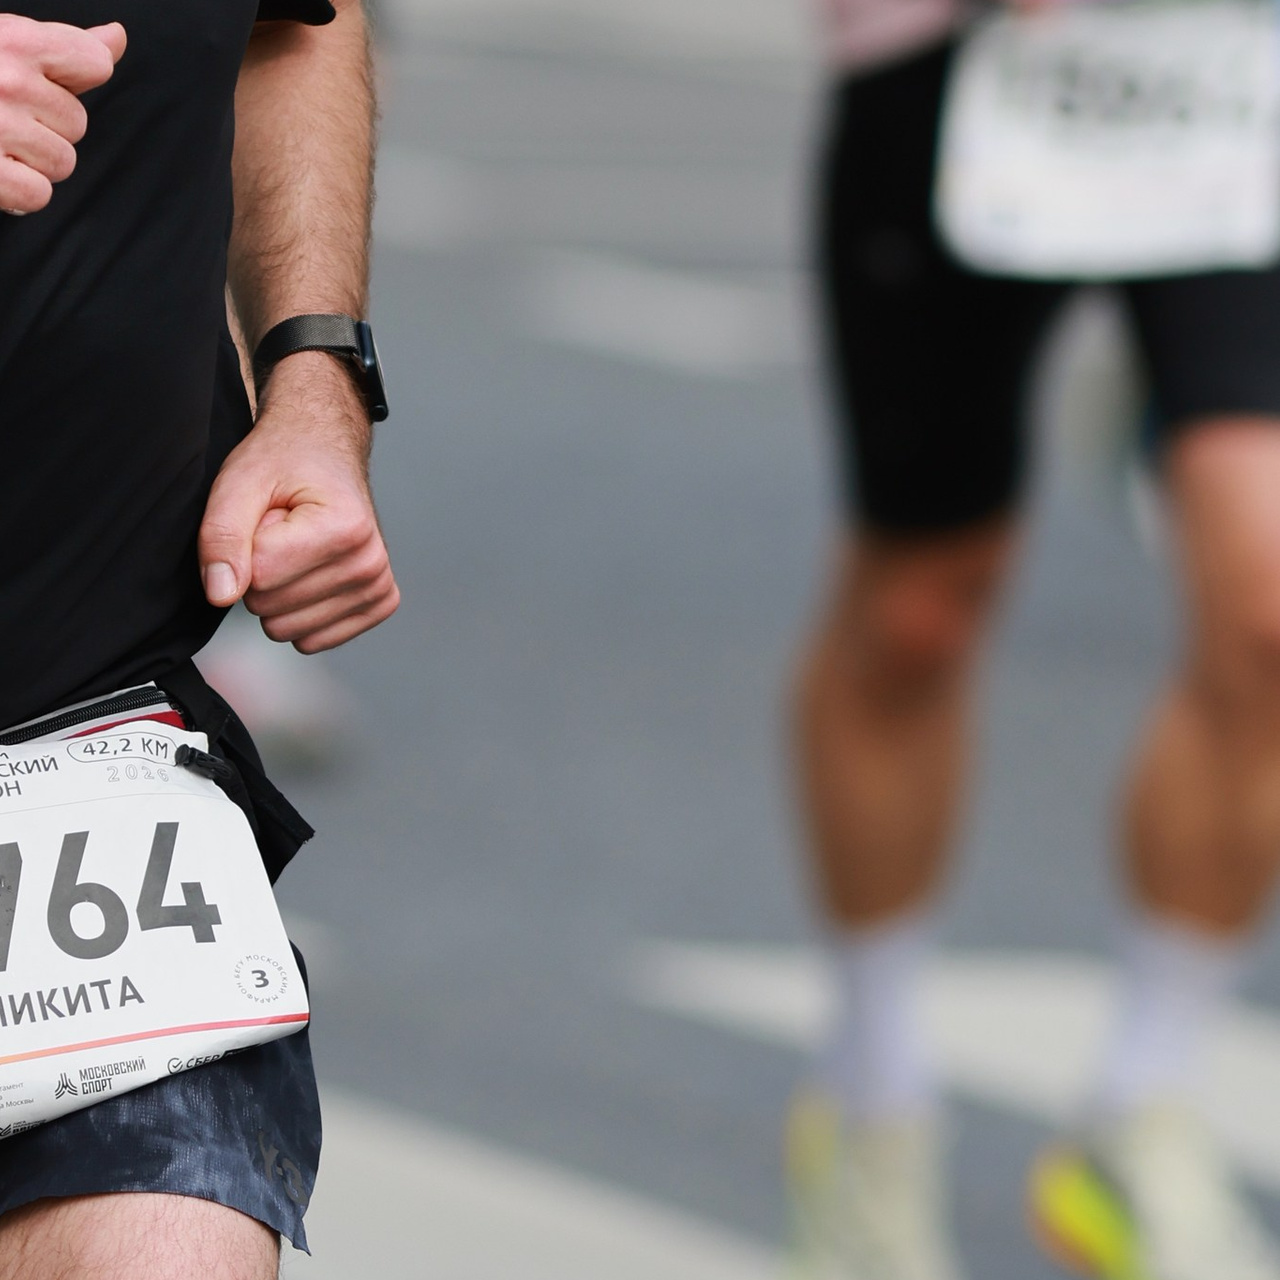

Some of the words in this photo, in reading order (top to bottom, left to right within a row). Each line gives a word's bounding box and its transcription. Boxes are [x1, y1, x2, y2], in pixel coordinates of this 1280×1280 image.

[82, 738, 133, 756] 42,2
[141, 737, 169, 759] КМ
[106, 763, 170, 783] 2026
[251, 969, 270, 988] 3
[78, 1056, 147, 1082] МОСКОВСКИЙ
[81, 1077, 113, 1095] СПОРТ
[5, 1098, 34, 1108] Москвы
